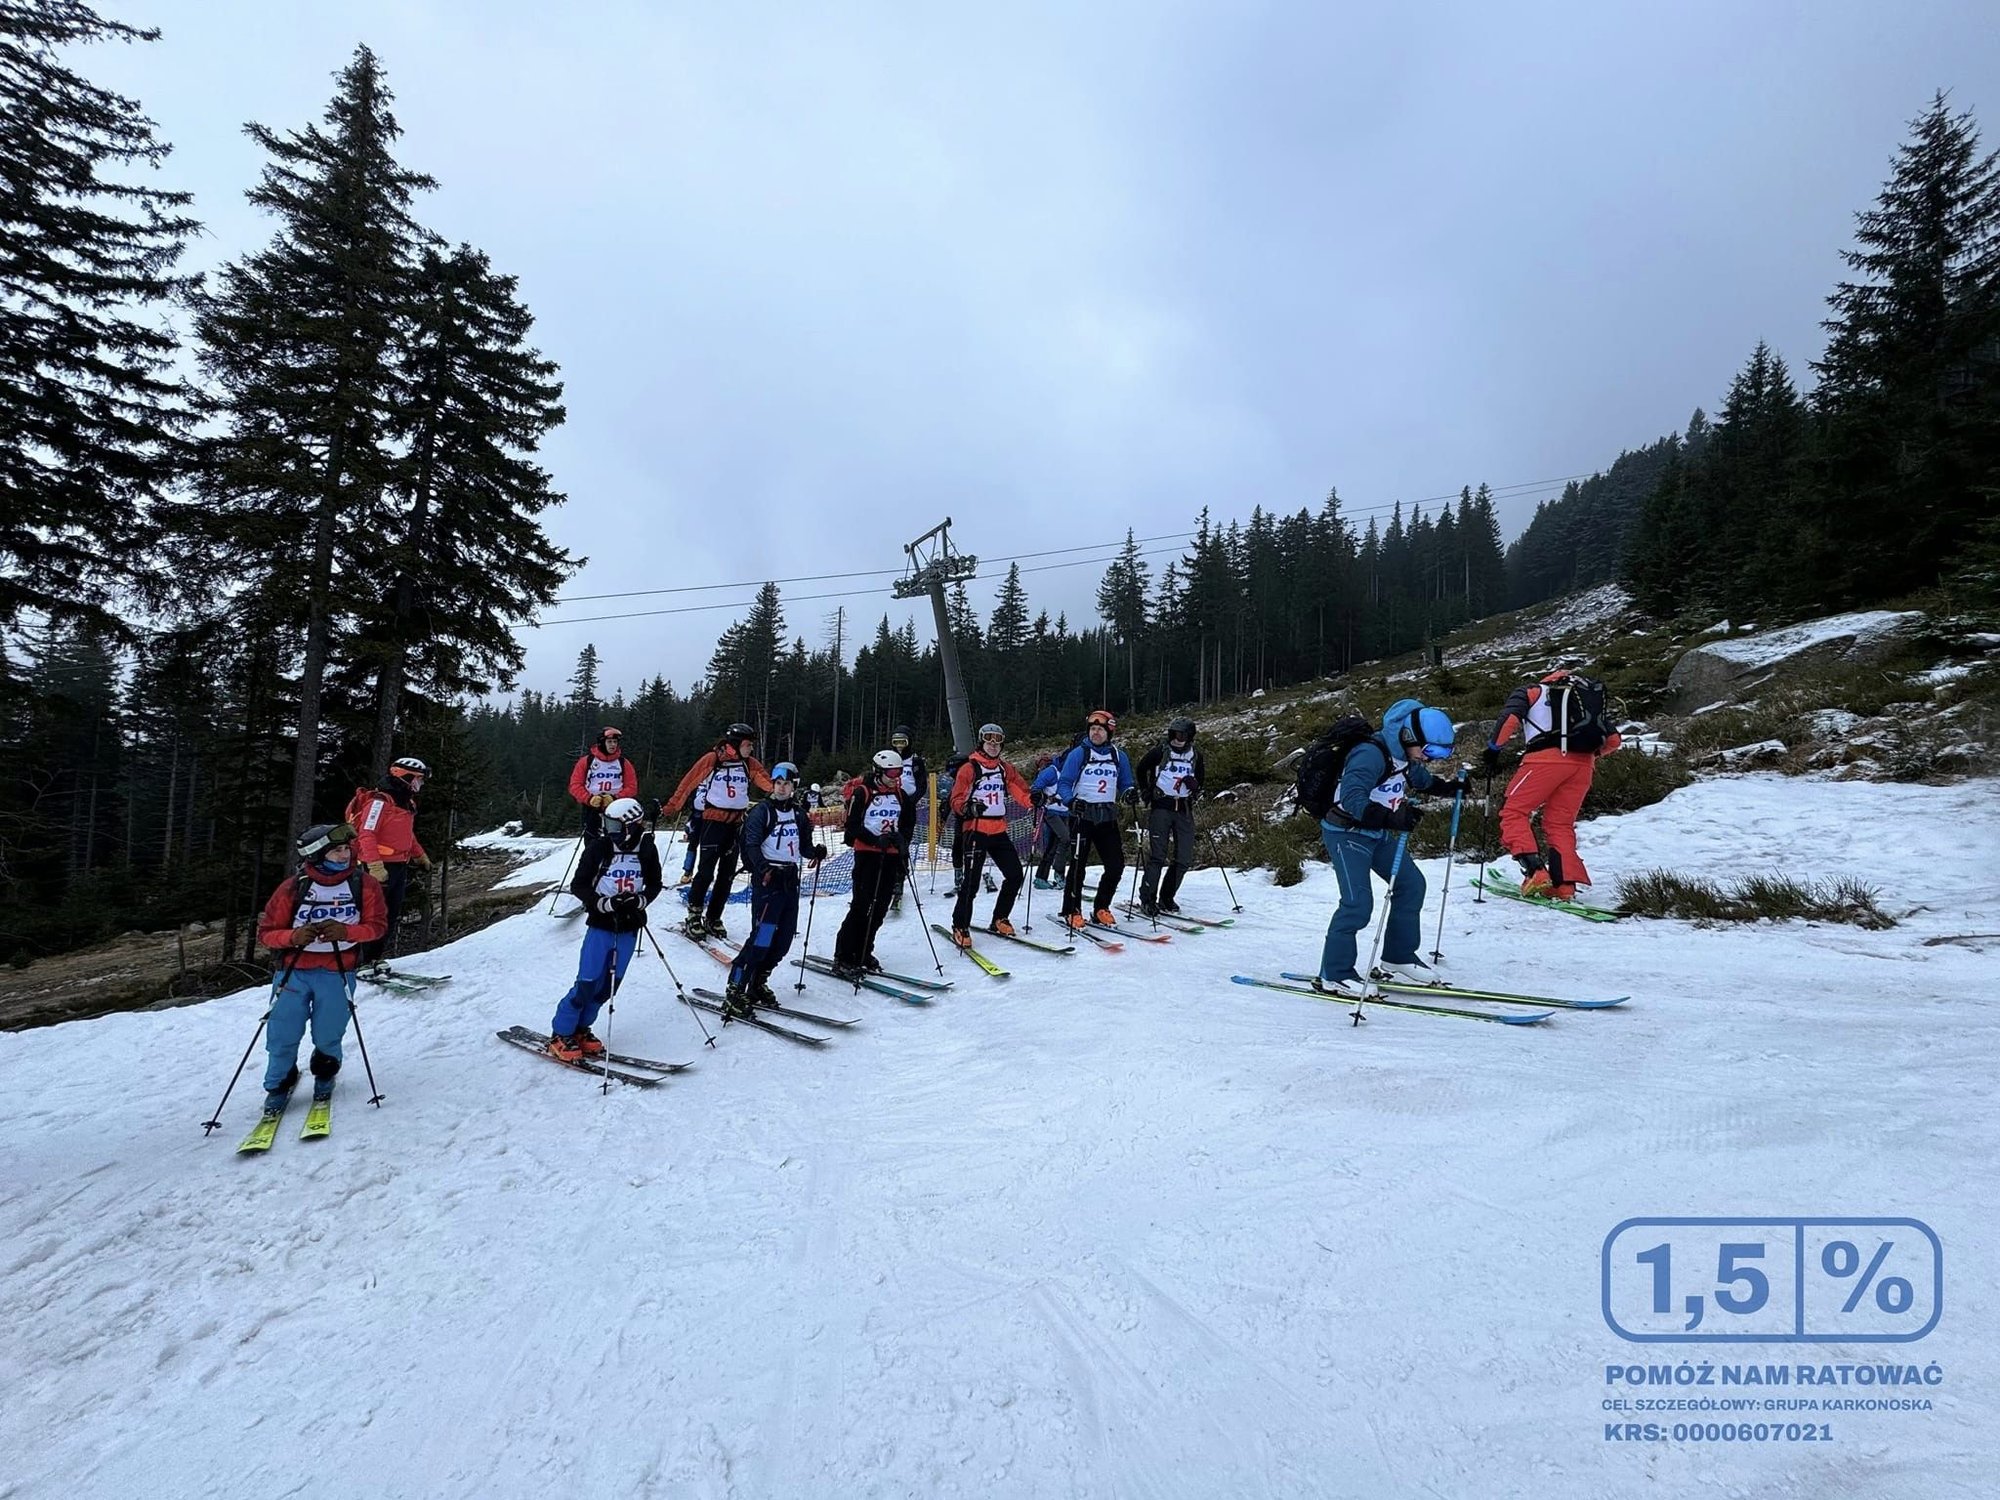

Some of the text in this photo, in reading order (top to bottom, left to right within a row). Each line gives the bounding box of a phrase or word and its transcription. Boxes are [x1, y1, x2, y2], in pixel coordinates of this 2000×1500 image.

[599, 781, 612, 791] 10
[727, 786, 736, 798] 6
[1098, 780, 1107, 793] 2
[985, 792, 999, 805] 11
